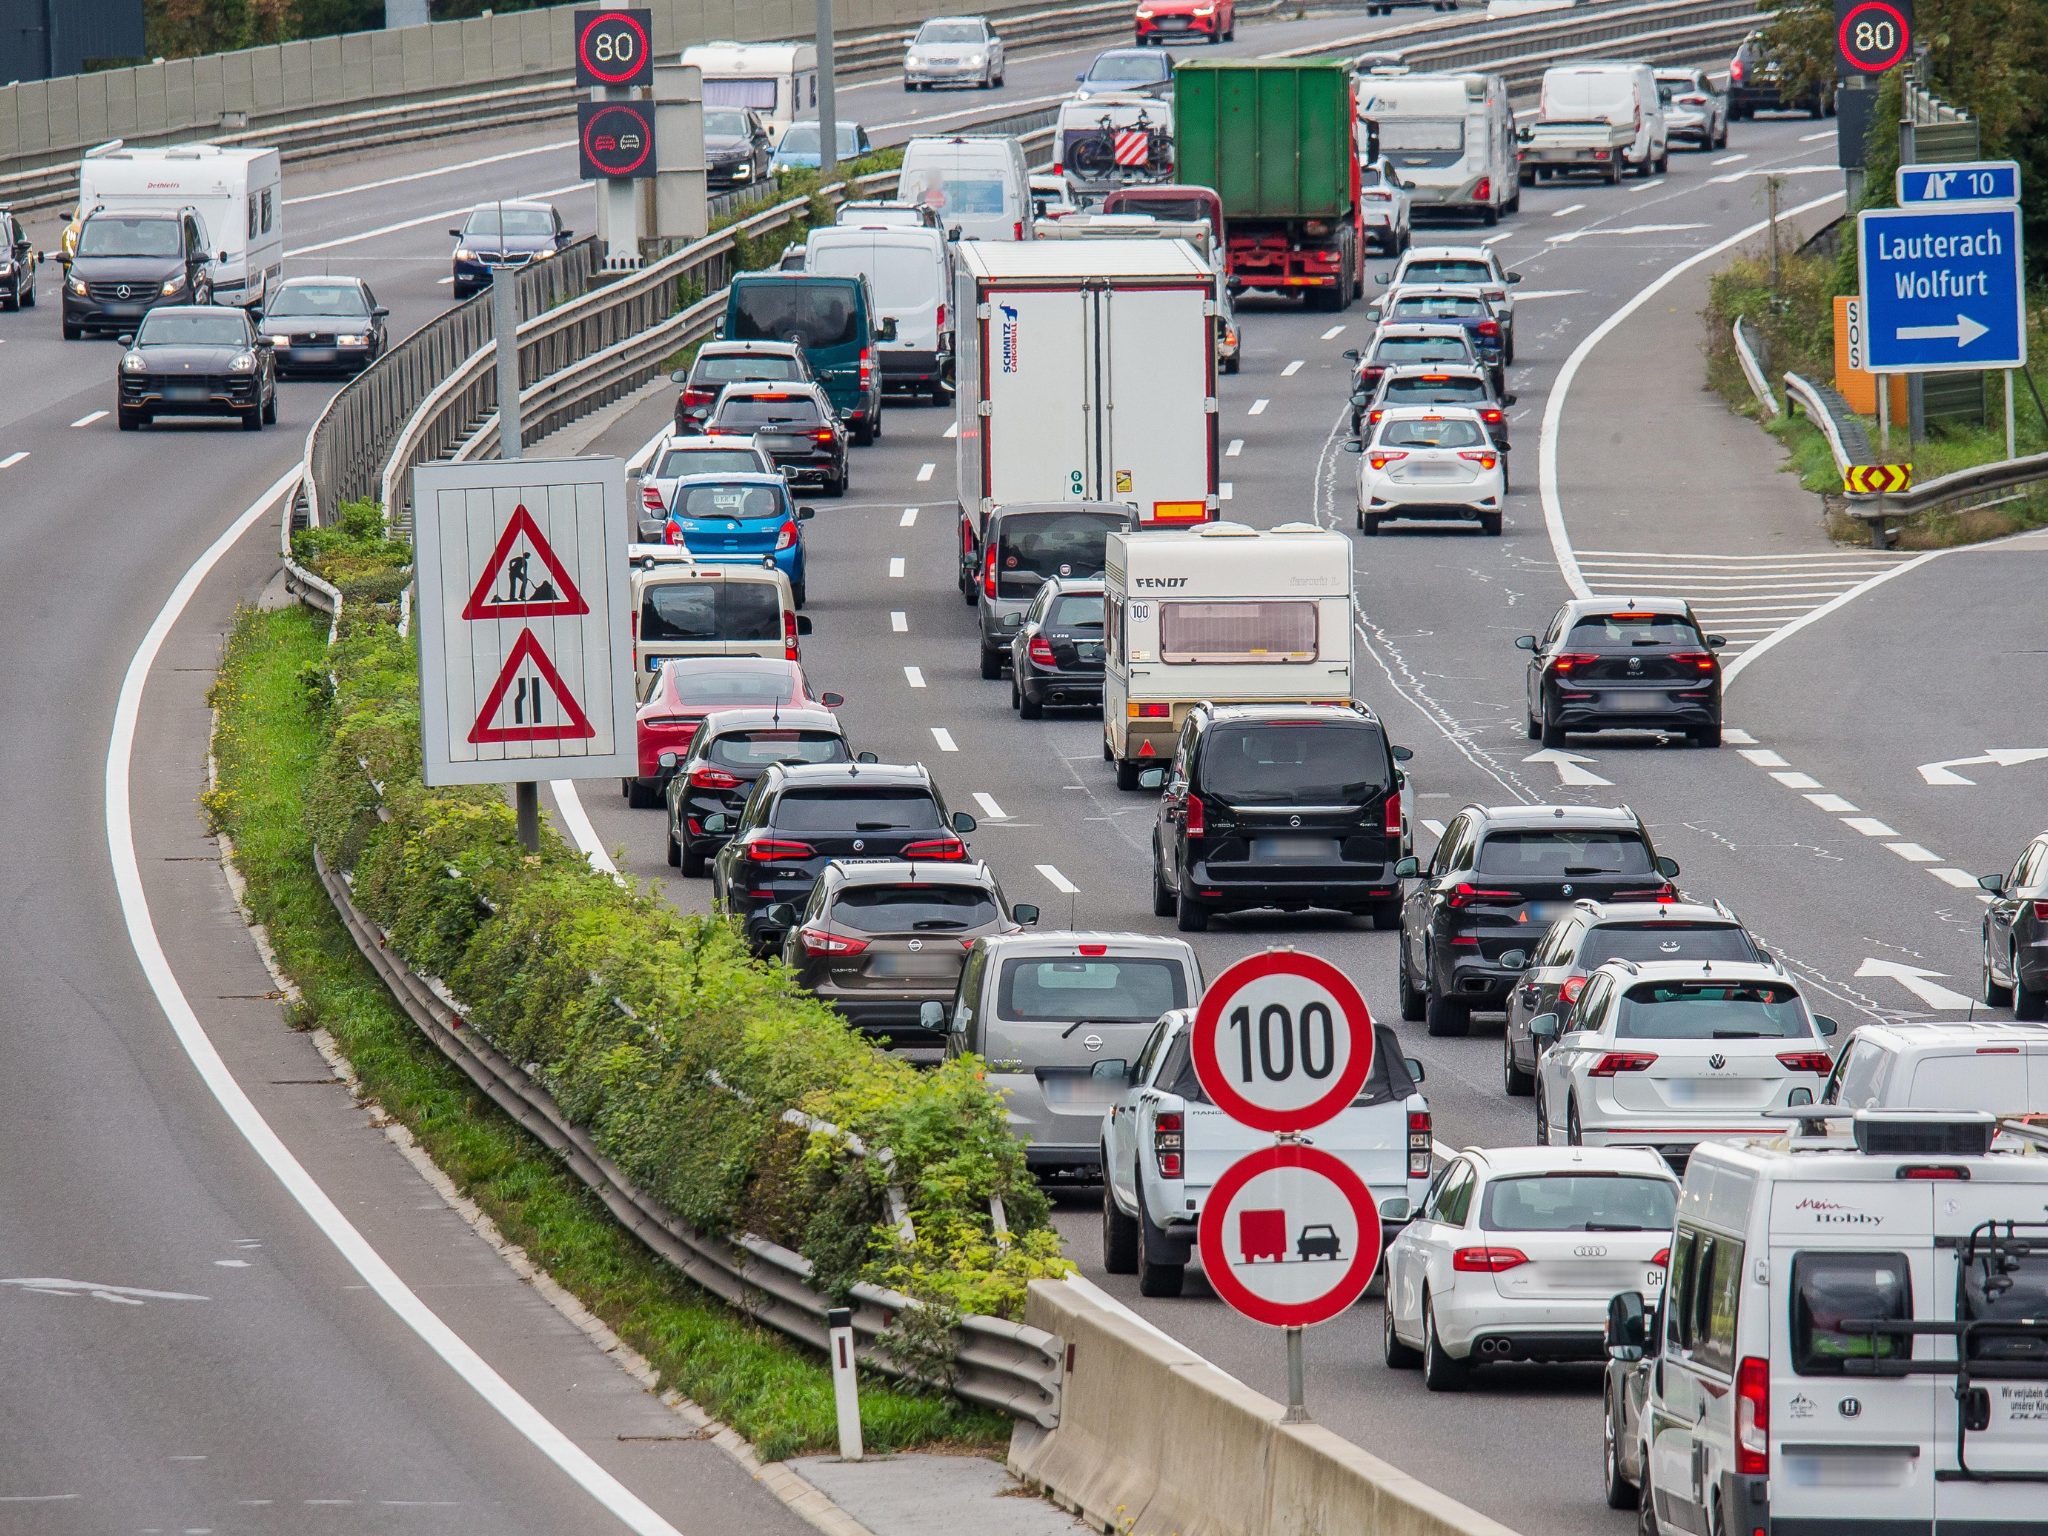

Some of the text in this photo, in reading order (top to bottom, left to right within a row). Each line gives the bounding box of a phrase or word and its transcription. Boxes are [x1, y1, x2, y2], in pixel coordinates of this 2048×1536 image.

[596, 32, 633, 61] 80
[1856, 21, 1894, 51] 80
[1967, 172, 1995, 195] 10
[1879, 228, 2002, 261] Lauterach
[1895, 269, 1989, 300] Wolfurt
[1003, 322, 1011, 373] SCHMITZ
[1849, 302, 1860, 368] SOS
[1135, 577, 1189, 588] FENDT
[1131, 605, 1149, 618] 100
[1230, 1001, 1335, 1083] 100
[1795, 1197, 1862, 1210] Mein
[1816, 1213, 1884, 1226] Hobby
[1647, 1271, 1663, 1286] CH
